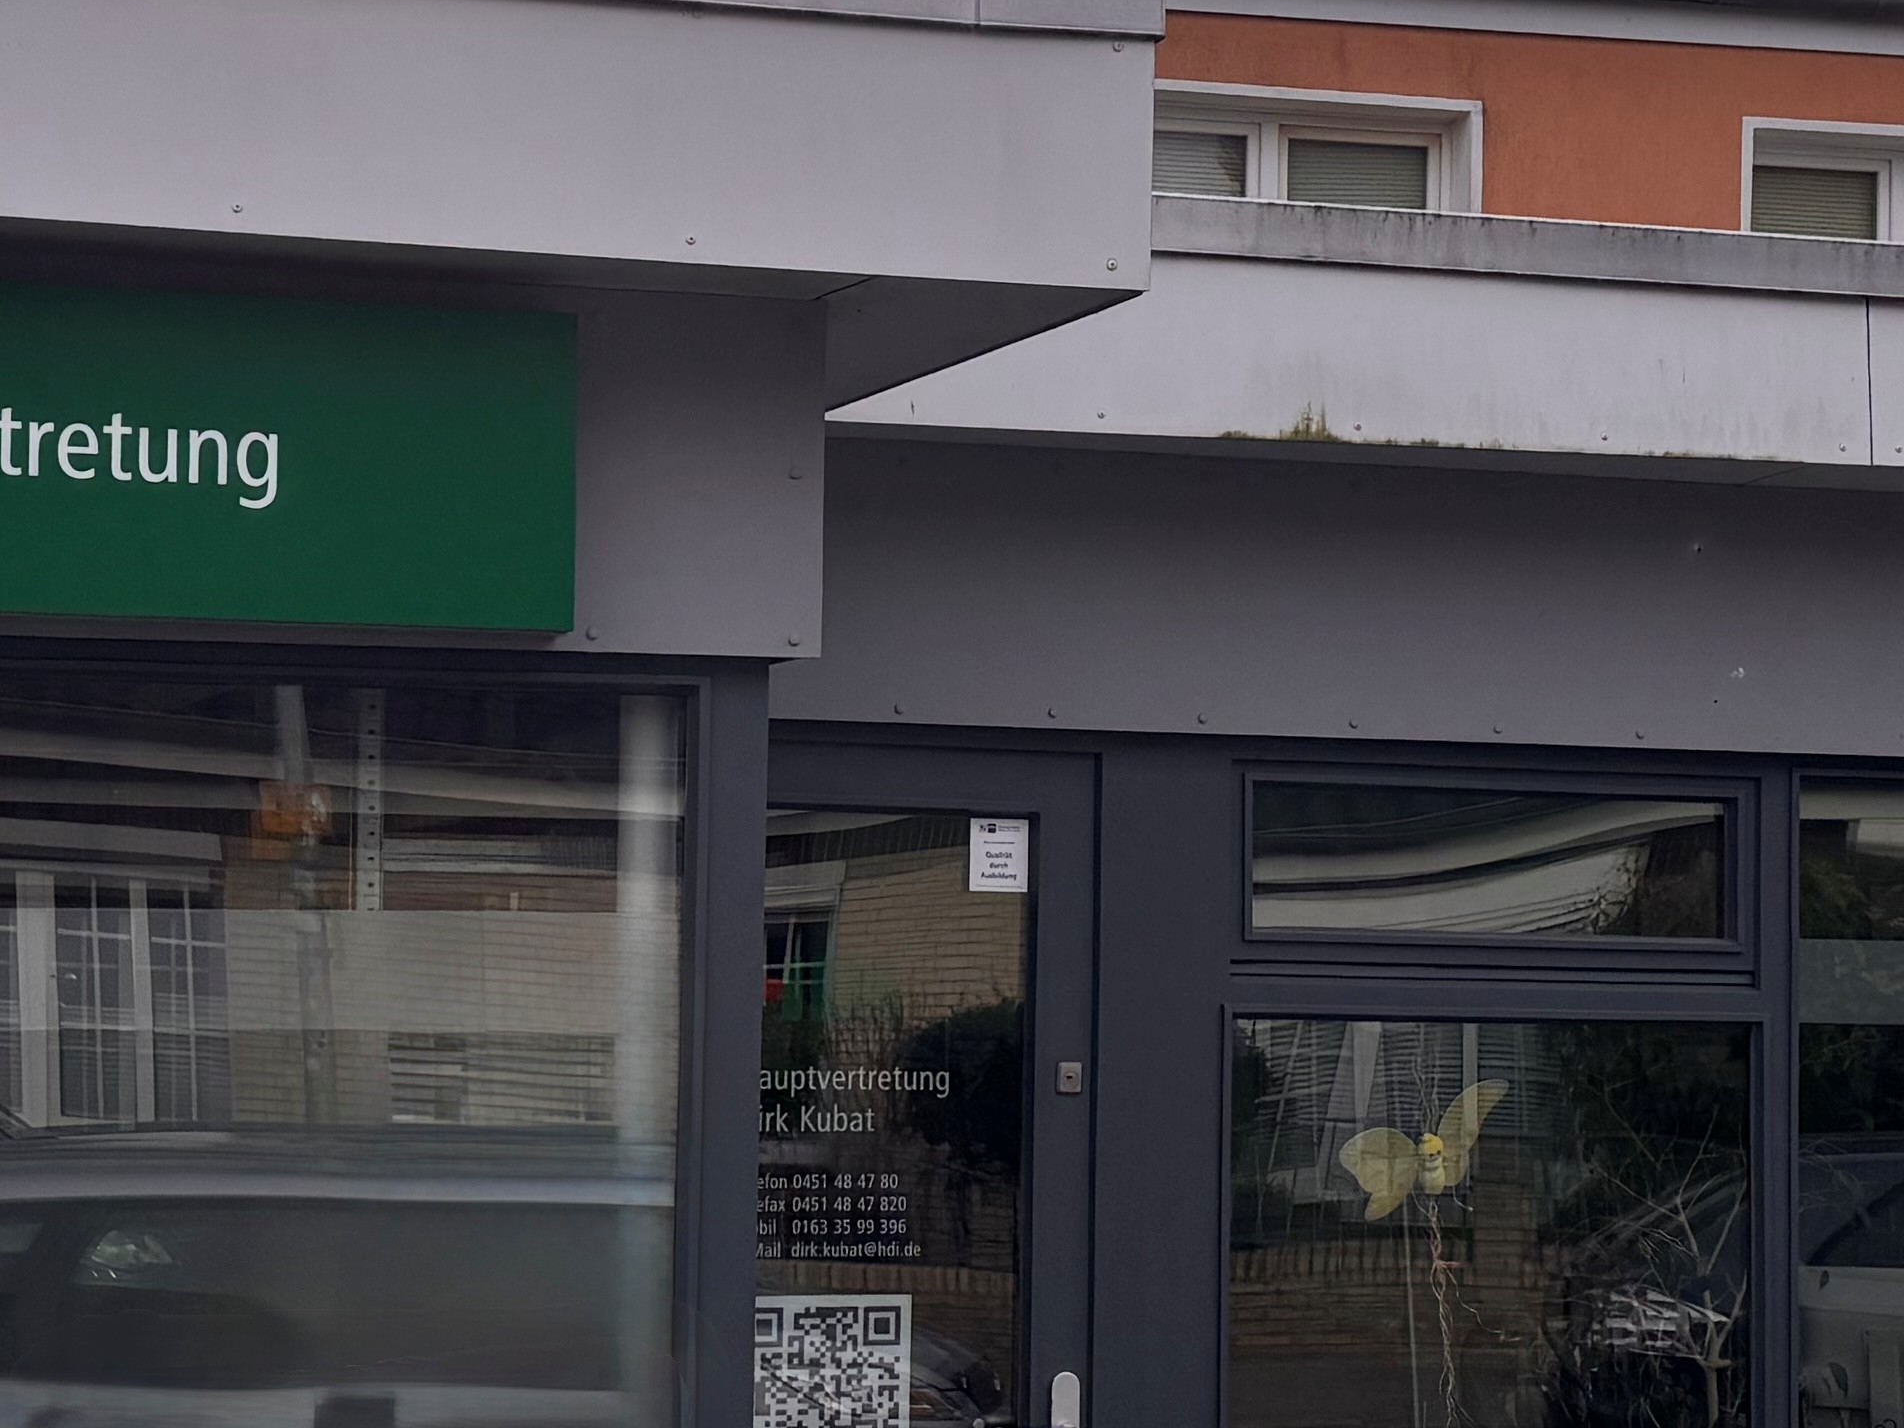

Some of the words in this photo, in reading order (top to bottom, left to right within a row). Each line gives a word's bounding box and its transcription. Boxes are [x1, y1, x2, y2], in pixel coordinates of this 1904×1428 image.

[759, 1065, 951, 1099] auptvertretung
[759, 1103, 790, 1133] irk
[799, 1102, 876, 1133] Kubat
[756, 1172, 789, 1190] efon
[792, 1173, 828, 1190] 0451
[833, 1173, 853, 1190] 48
[857, 1173, 876, 1190] 47
[880, 1173, 899, 1190] 80
[756, 1195, 786, 1213] efax
[791, 1196, 828, 1213] 0451
[833, 1196, 852, 1212] 48
[857, 1196, 875, 1212] 47
[879, 1196, 907, 1212] 820
[791, 1218, 828, 1235] 0163
[833, 1218, 852, 1235] 35
[856, 1218, 875, 1235] 99
[879, 1218, 907, 1235] 396
[790, 1240, 922, 1258] dirk.kubat@hdi.de
